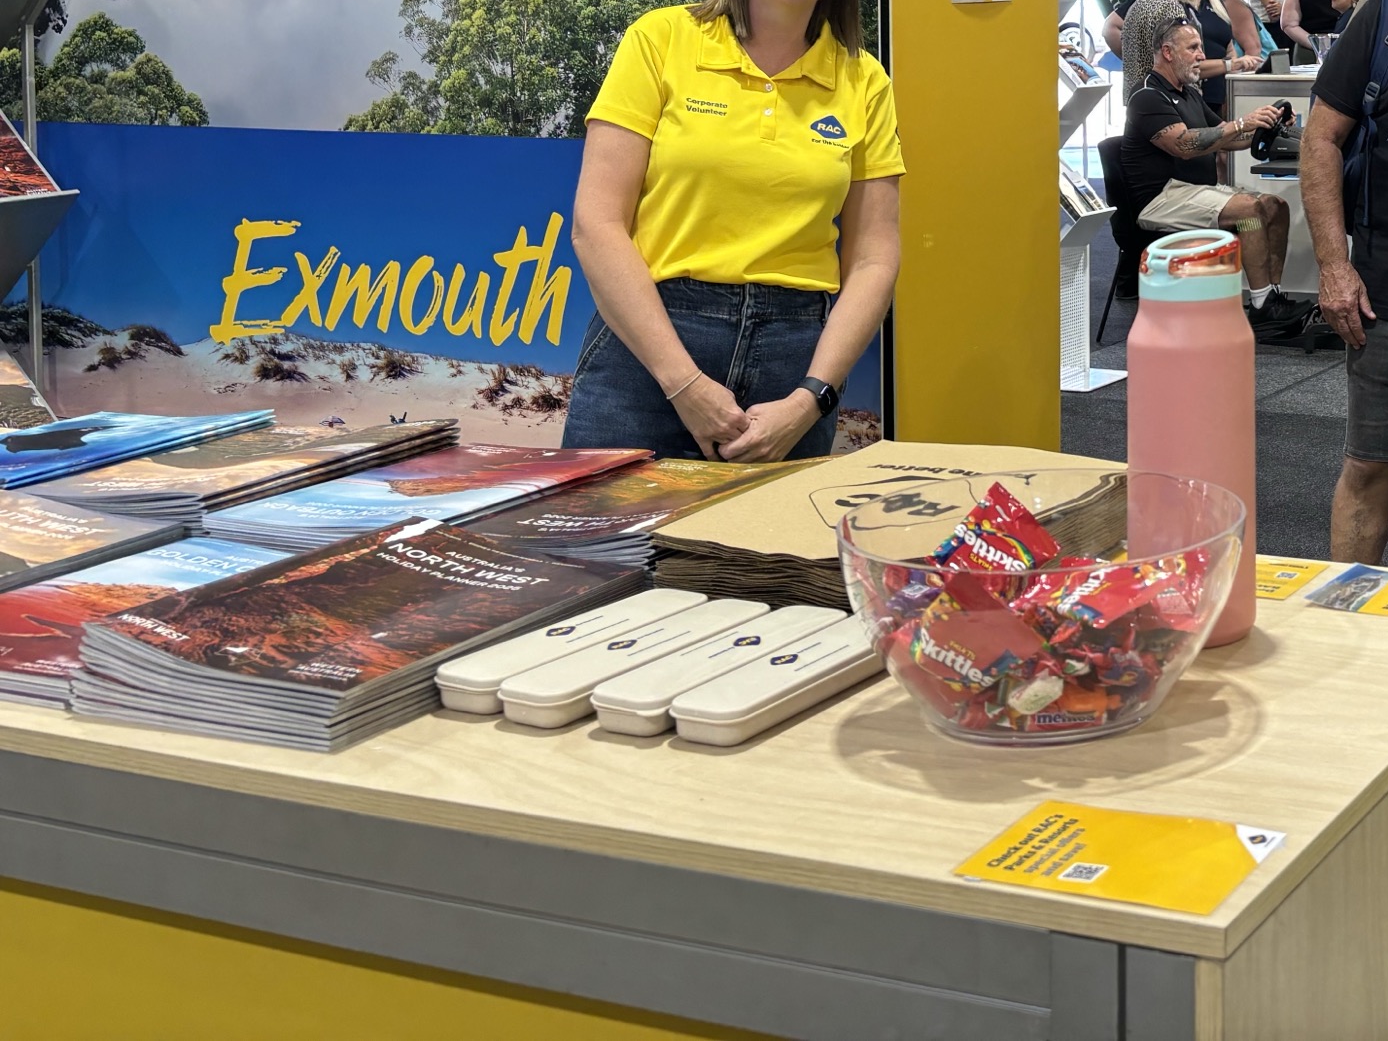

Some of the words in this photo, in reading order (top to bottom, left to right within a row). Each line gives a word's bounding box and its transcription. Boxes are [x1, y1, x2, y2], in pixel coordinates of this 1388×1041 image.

[686, 97, 728, 109] Corporate
[686, 105, 728, 117] Volunteer
[816, 122, 842, 135] RAC
[209, 212, 572, 346] Exmouth
[37, 520, 107, 536] WEST
[146, 548, 238, 570] GOLDEN
[954, 523, 1026, 572] Skittles
[376, 552, 432, 574] HOLIDAY
[429, 571, 489, 589] PLANNER
[388, 542, 475, 574] NORTH
[474, 569, 550, 586] WEST
[445, 551, 526, 573] AUSTRALIA'S
[117, 613, 158, 630] NORTH
[154, 625, 192, 641] WEST
[310, 662, 364, 674] WESTERN
[920, 628, 995, 688] Skittles
[297, 664, 357, 678] AUSTRALIA
[987, 843, 1022, 868] Check
[1018, 833, 1040, 846] out
[1003, 848, 1036, 872] Parks
[1040, 818, 1079, 845] Resorts
